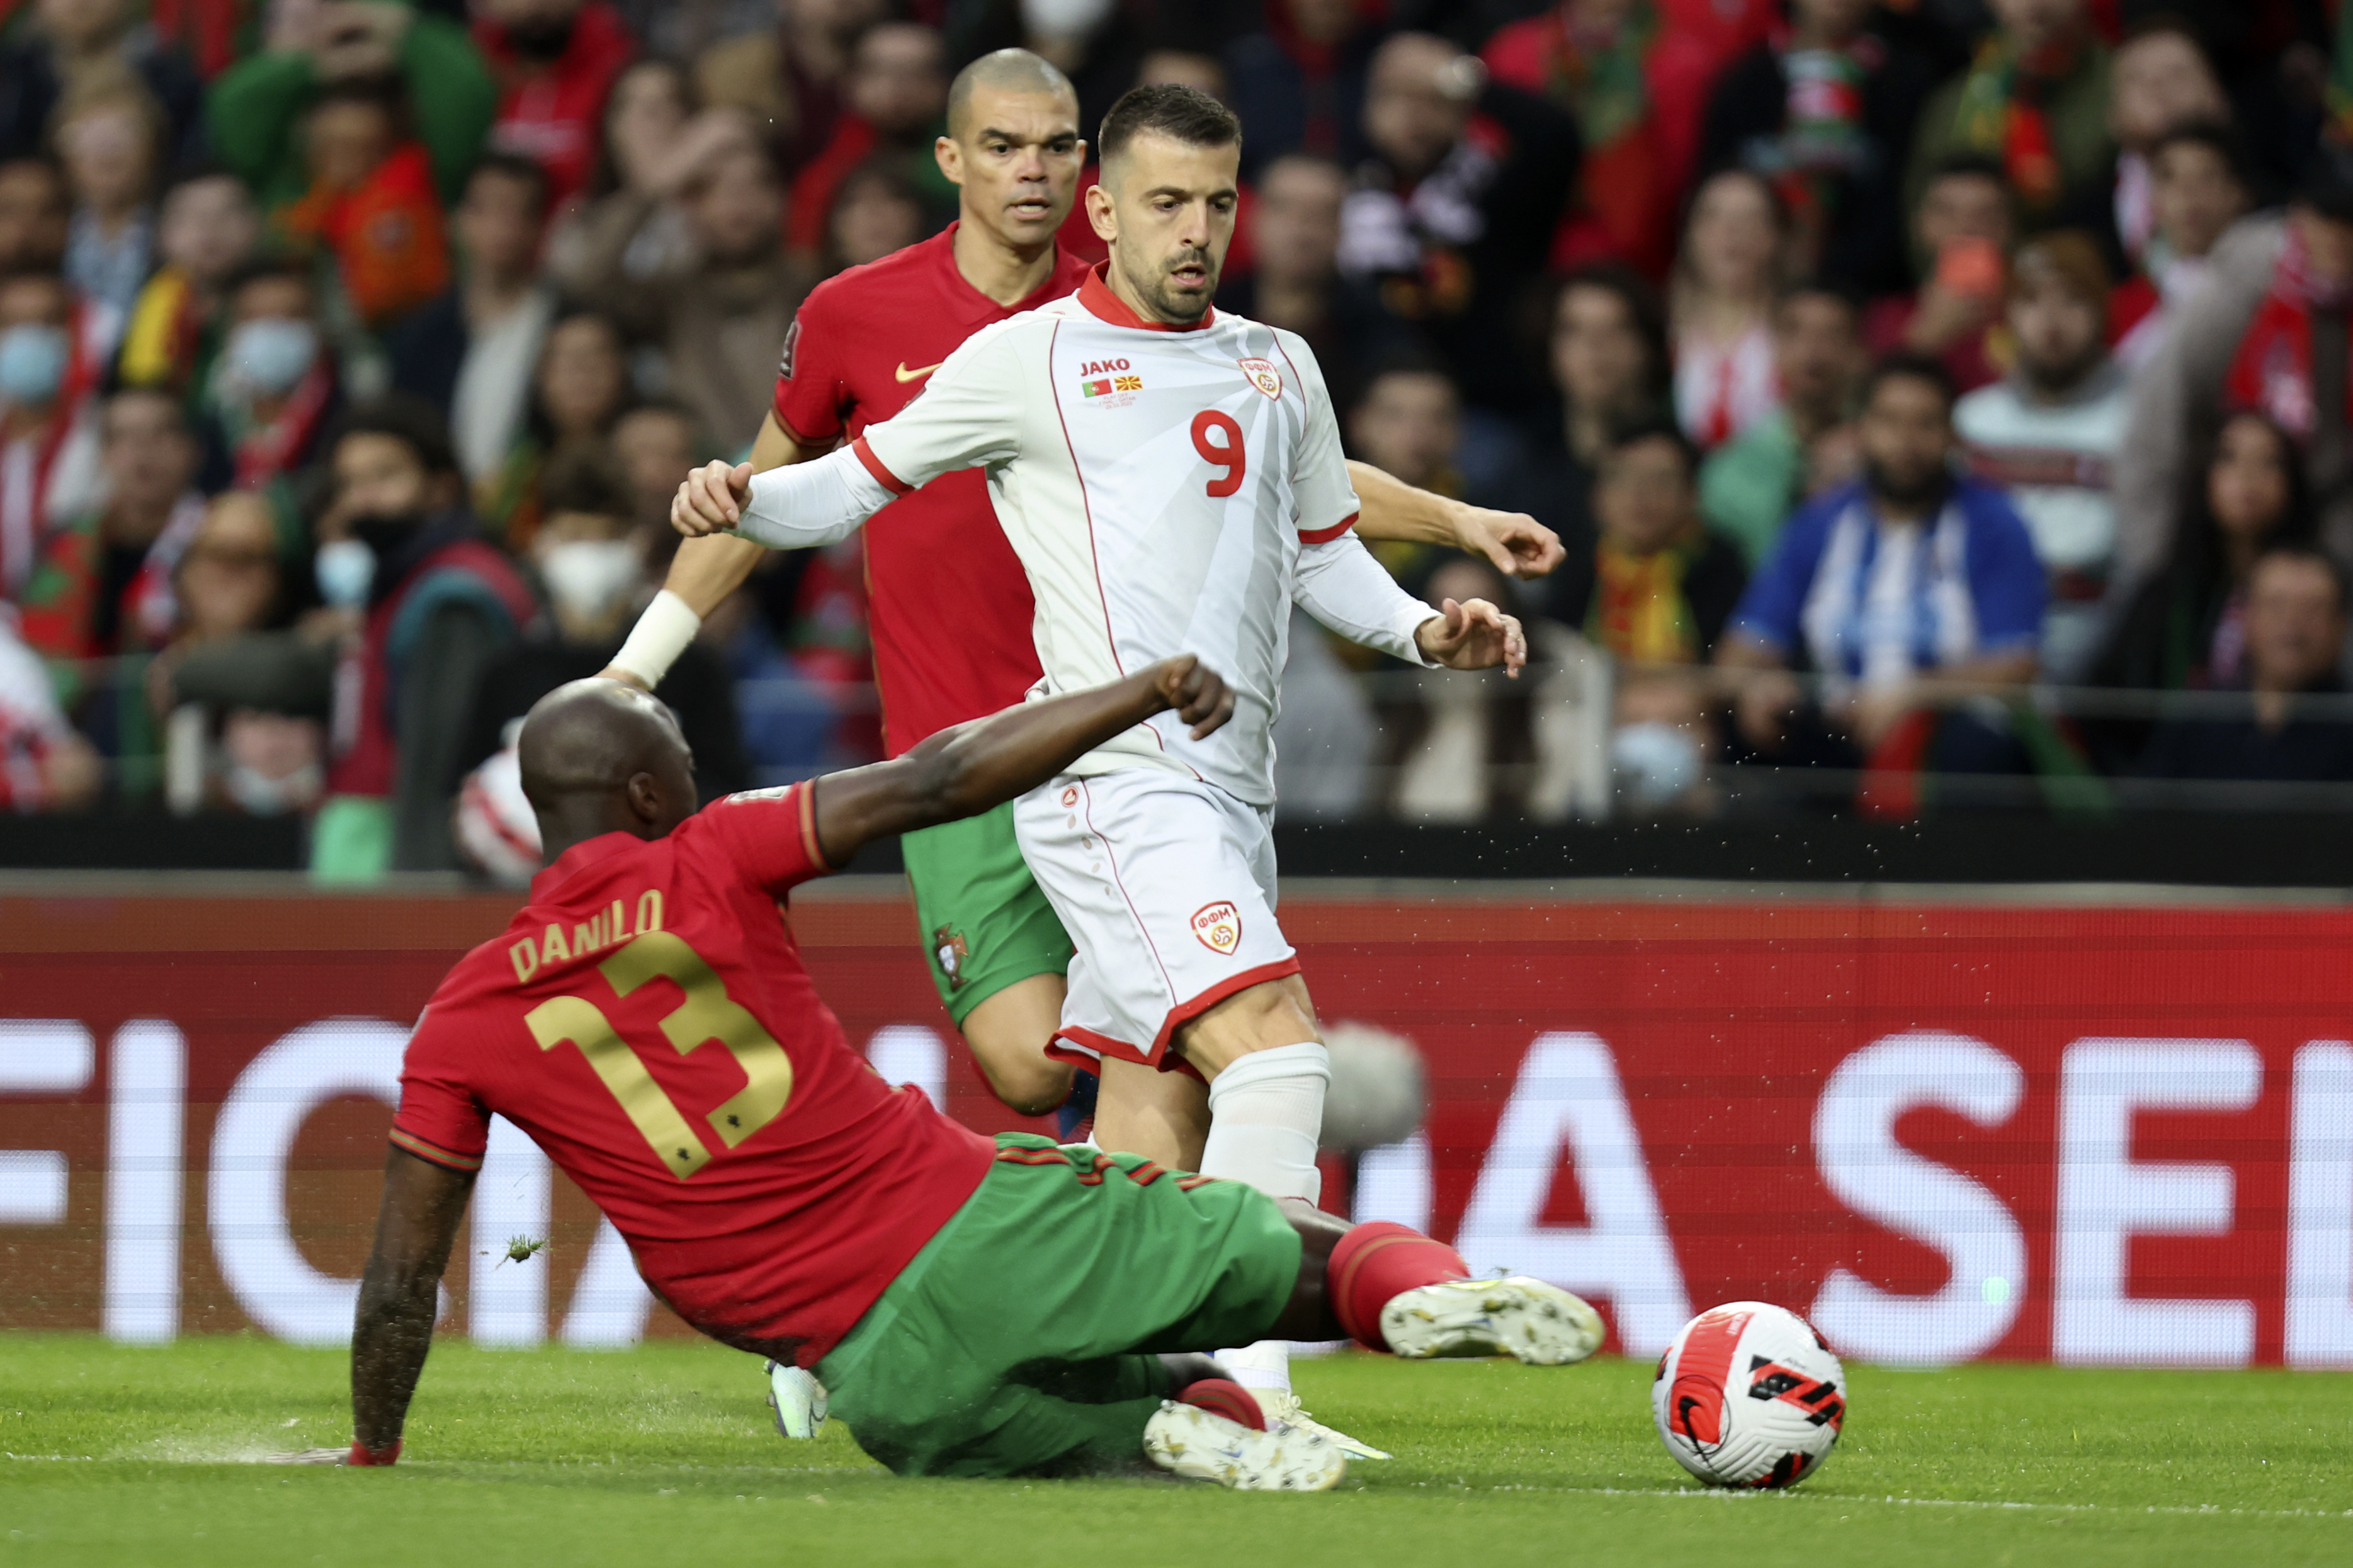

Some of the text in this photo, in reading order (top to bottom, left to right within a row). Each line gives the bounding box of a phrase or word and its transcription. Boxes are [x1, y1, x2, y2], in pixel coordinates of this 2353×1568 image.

[1080, 358, 1130, 377] JAKO
[1190, 409, 1245, 497] 9
[509, 888, 663, 983] DANILO
[1198, 907, 1231, 928] ФФМ
[523, 930, 793, 1181] 13
